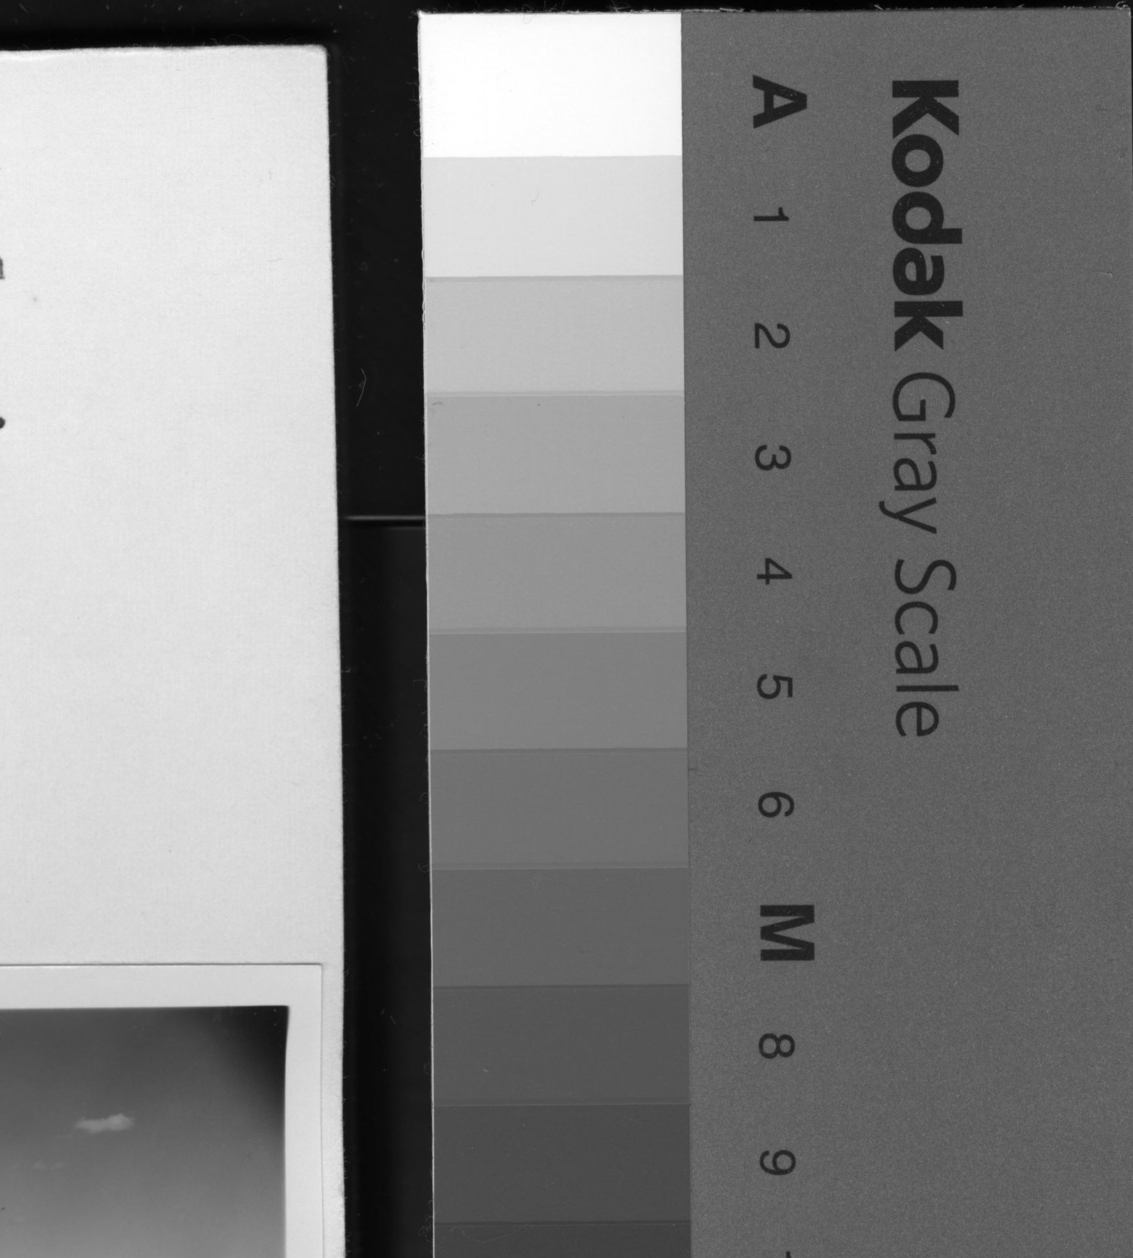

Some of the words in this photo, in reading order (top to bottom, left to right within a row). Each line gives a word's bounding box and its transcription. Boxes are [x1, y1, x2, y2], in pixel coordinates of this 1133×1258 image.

[752, 75, 807, 128] A
[753, 207, 789, 222] 1
[891, 80, 963, 351] Kodak
[754, 323, 790, 349] 2
[754, 445, 792, 471] 3
[879, 372, 956, 534] Gray
[757, 558, 793, 585] 4
[894, 559, 959, 737] Scale
[757, 674, 793, 700] 5
[758, 791, 795, 818] 6
[760, 904, 815, 961] M
[758, 1033, 795, 1059] 8
[759, 1150, 796, 1176] 9
